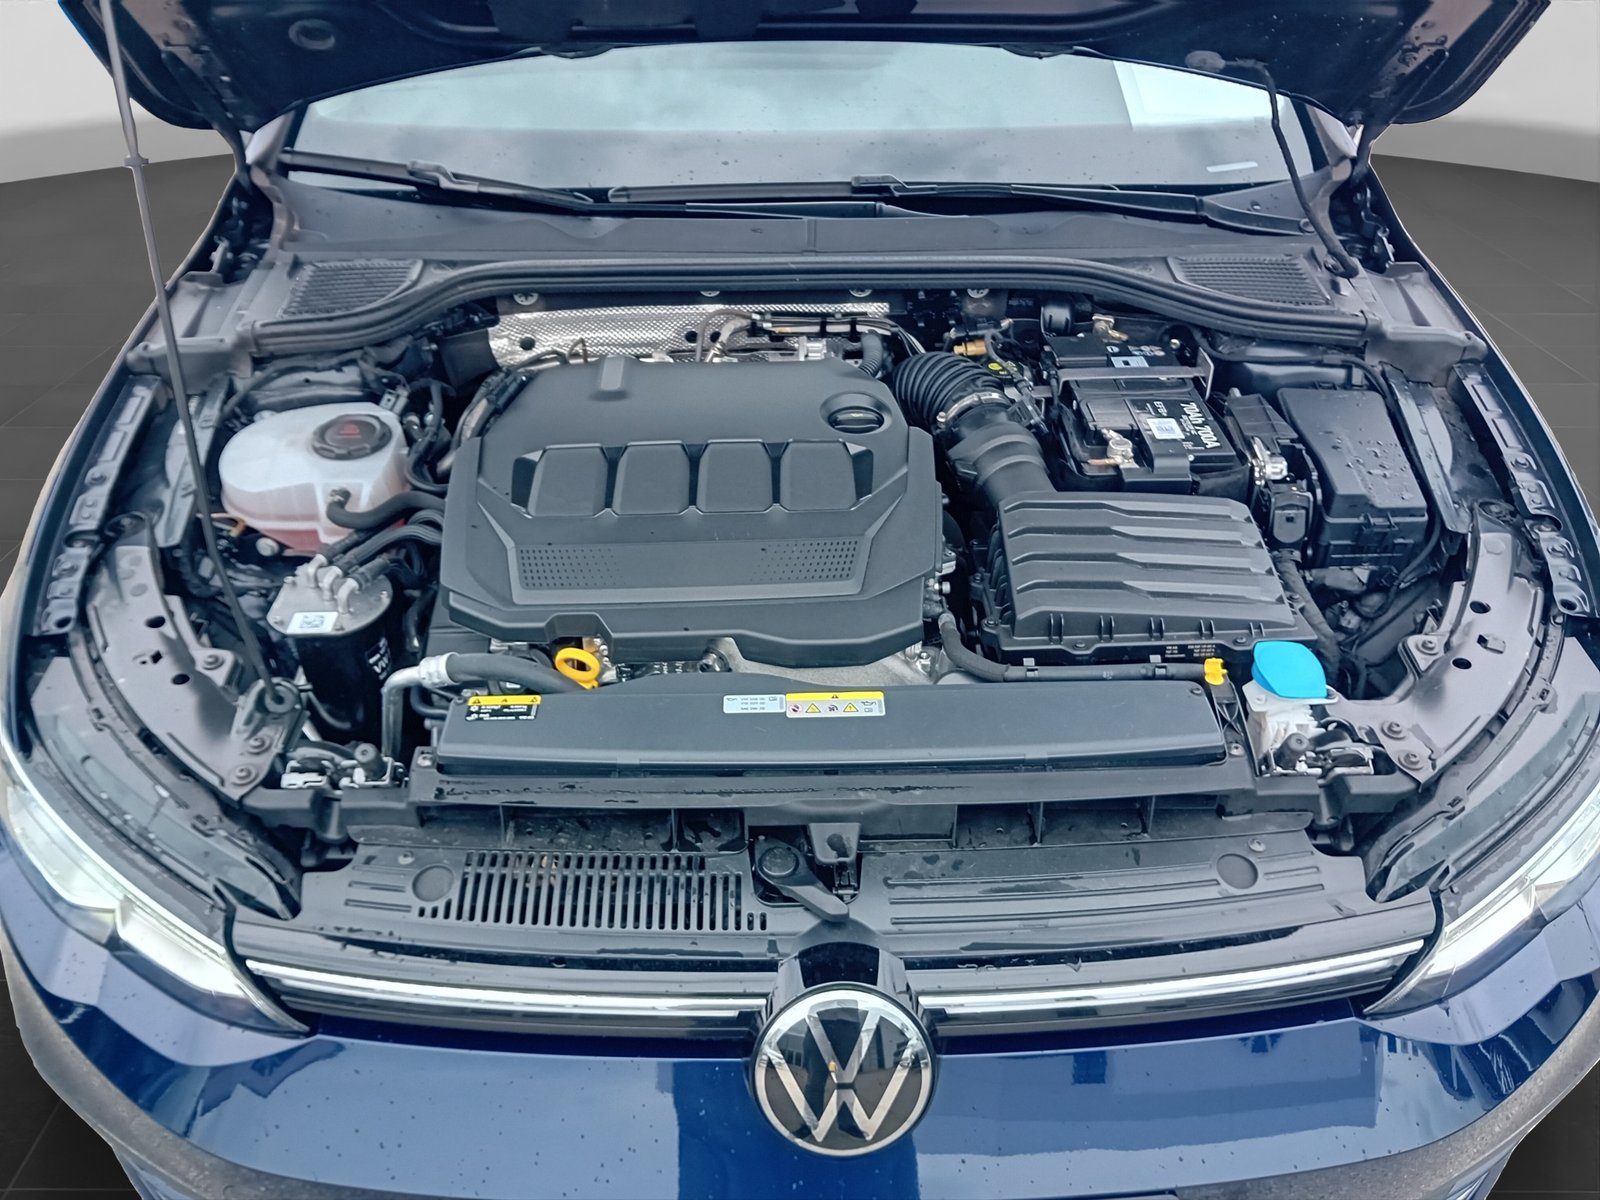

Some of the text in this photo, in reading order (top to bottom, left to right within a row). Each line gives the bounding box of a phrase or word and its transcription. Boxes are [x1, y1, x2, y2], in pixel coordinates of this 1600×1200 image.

[1180, 402, 1206, 425] 70Ah
[1194, 425, 1221, 449] 700A
[757, 992, 929, 1153] VW
